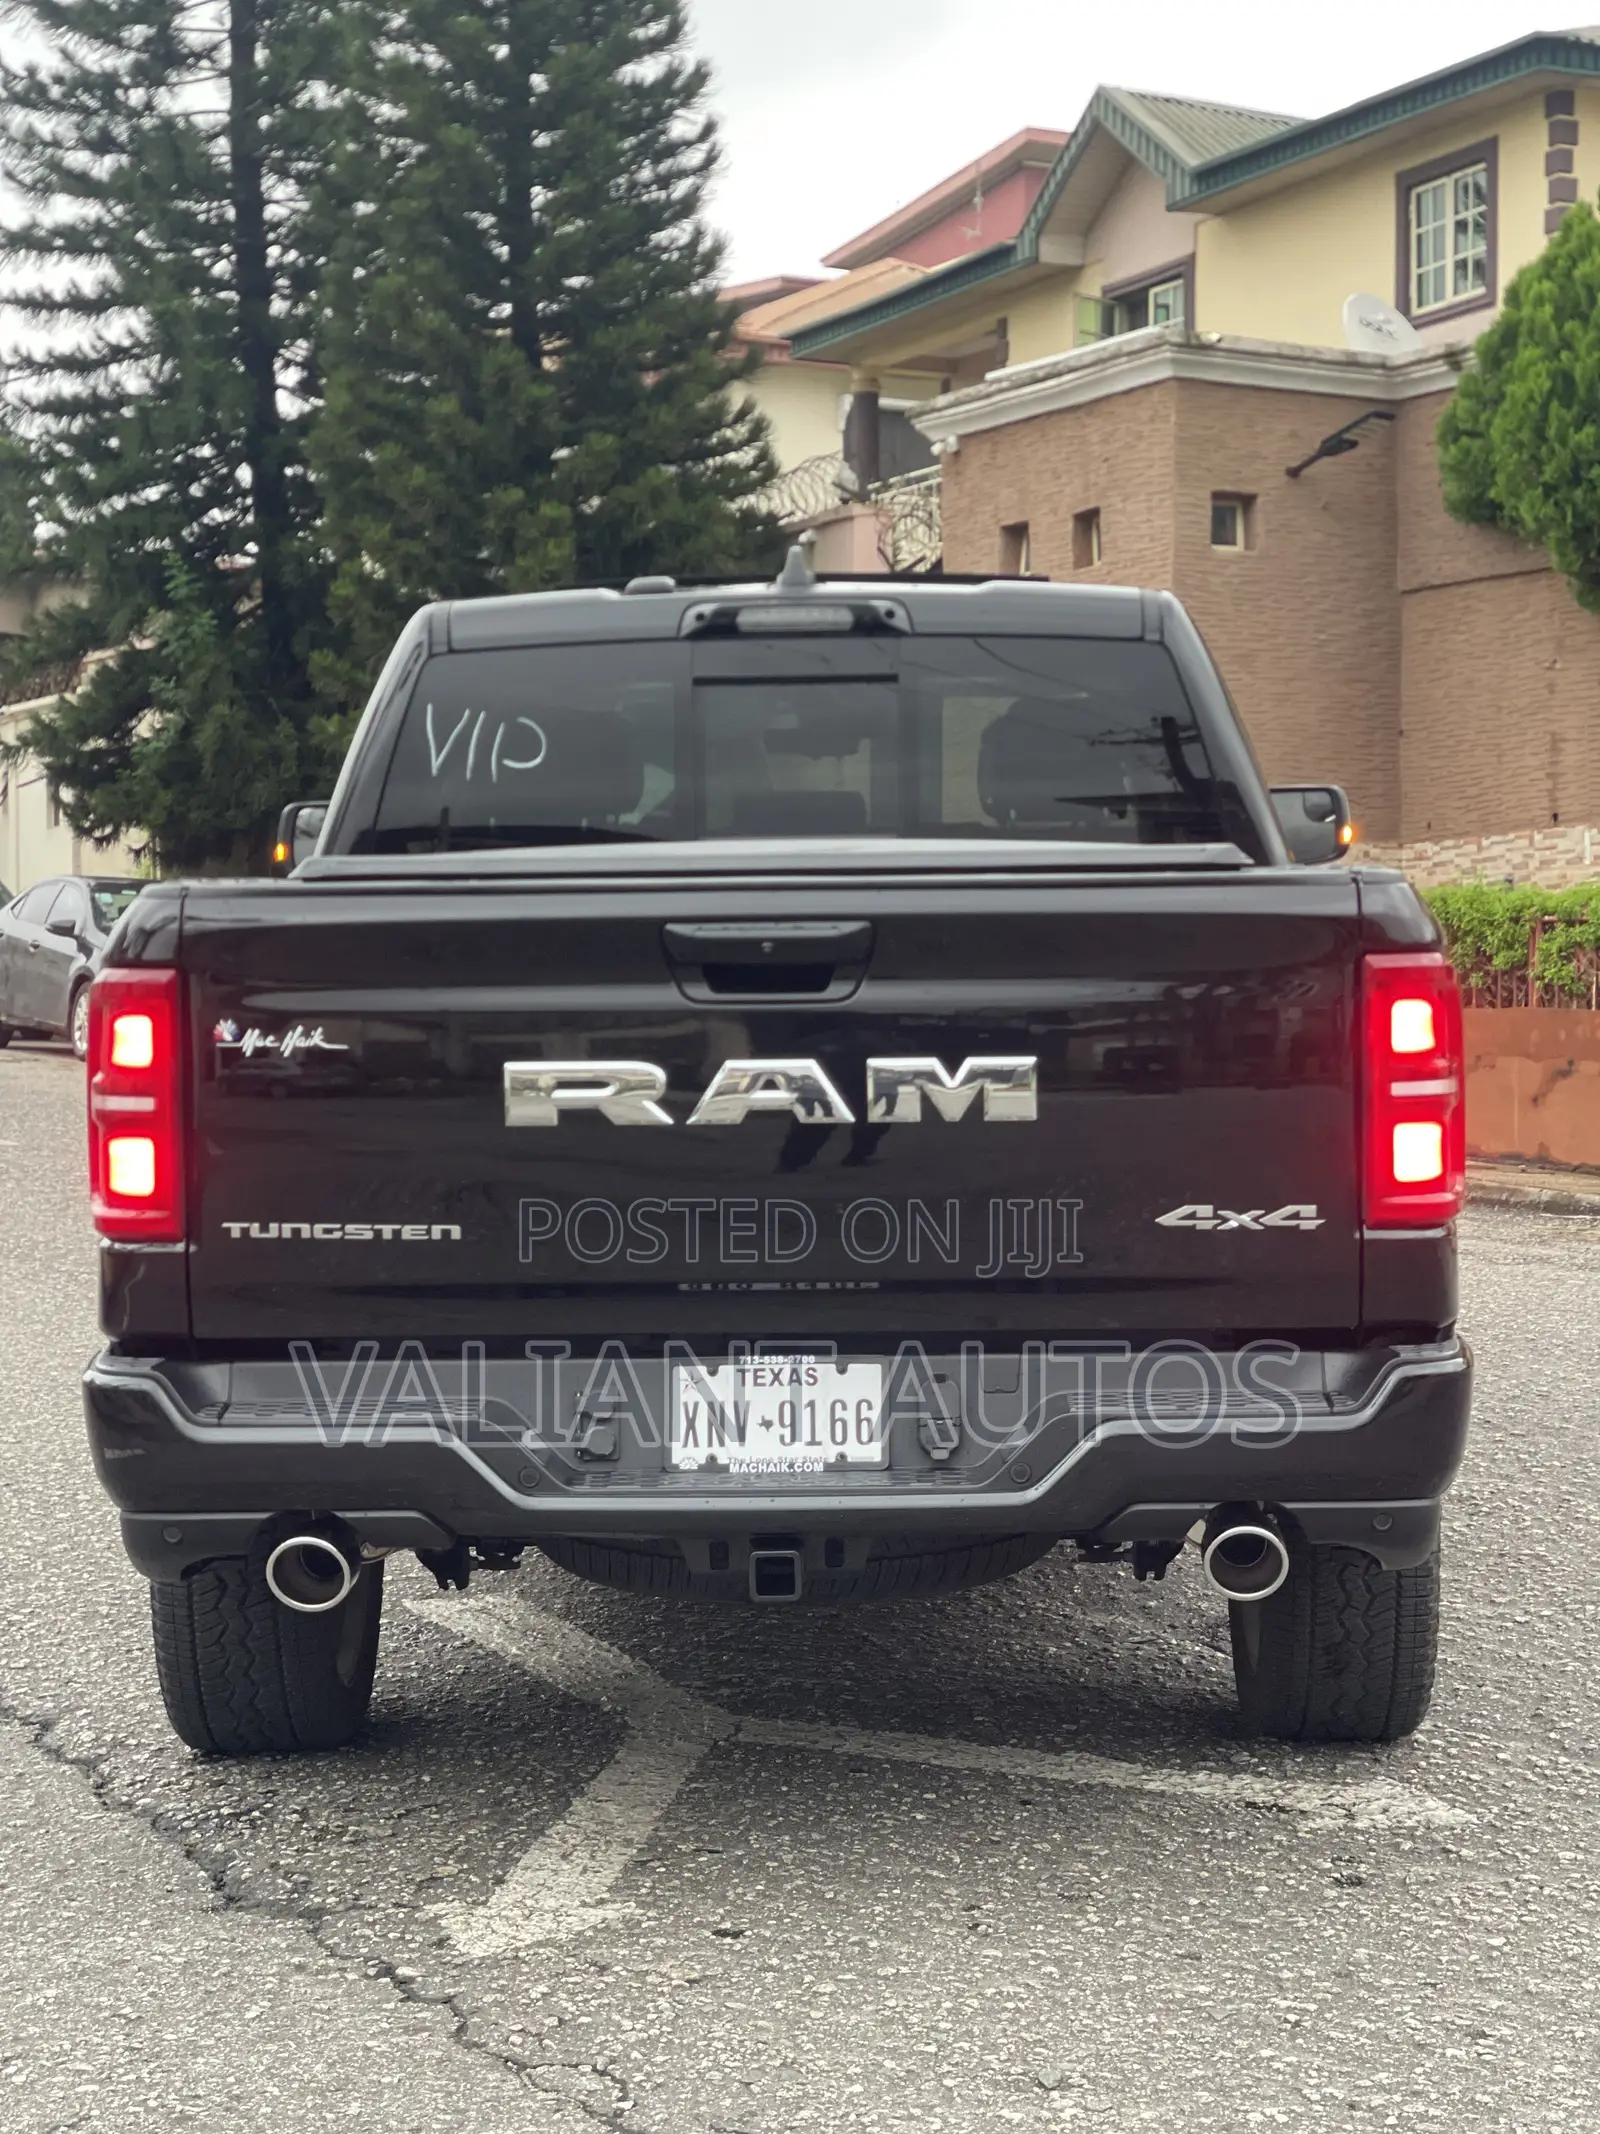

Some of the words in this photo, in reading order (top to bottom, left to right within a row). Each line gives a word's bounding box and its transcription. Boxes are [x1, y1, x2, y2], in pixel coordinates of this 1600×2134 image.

[425, 702, 548, 784] VIP
[239, 1027, 280, 1058] Mac
[280, 1024, 350, 1058] Haik
[503, 1056, 1038, 1127] RAM
[221, 1221, 463, 1241] TUNGSTEN
[1154, 1204, 1328, 1231] 4x4
[735, 1366, 819, 1388] TEXAS
[681, 1400, 751, 1448] XNV
[777, 1398, 874, 1447] 9166
[729, 1461, 824, 1473] MACHAIK.COM
